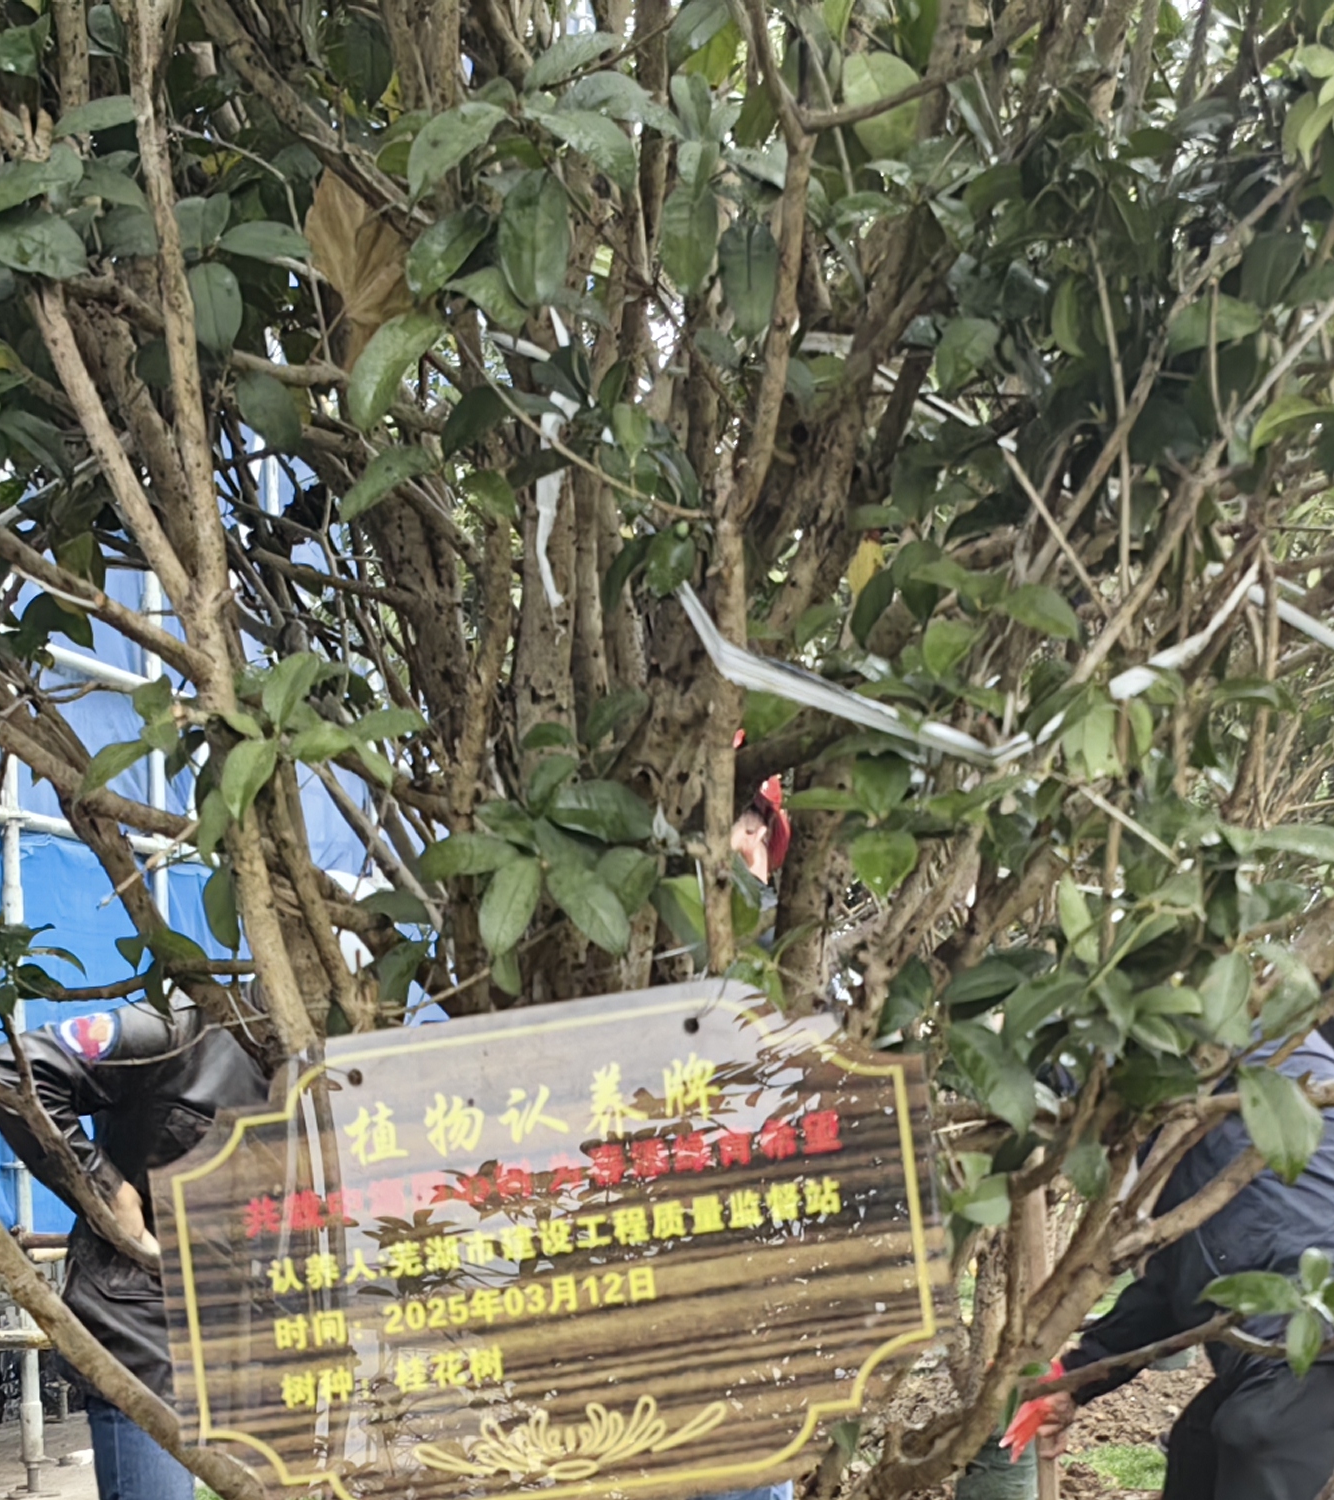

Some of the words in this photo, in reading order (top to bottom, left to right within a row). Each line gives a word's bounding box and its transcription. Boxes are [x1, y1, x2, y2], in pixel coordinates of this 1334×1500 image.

[344, 1052, 721, 1166] 植物认养牌
